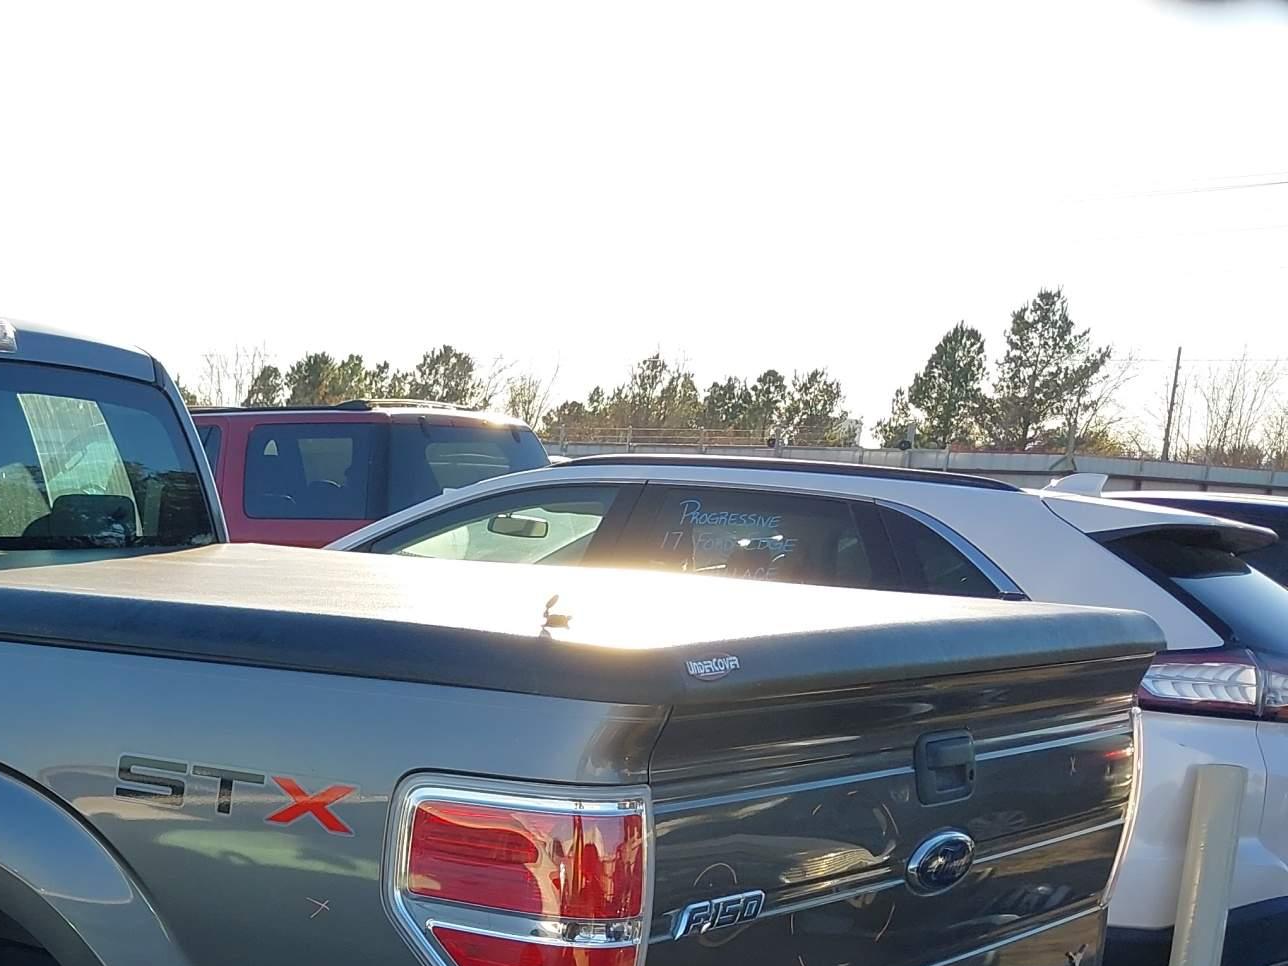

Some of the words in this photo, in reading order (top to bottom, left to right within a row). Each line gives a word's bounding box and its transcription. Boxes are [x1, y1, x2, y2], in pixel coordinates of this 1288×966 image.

[679, 499, 783, 528] PROGRESSIVE
[660, 531, 684, 550] 17
[743, 532, 799, 552] EDGE
[114, 754, 358, 836] STX
